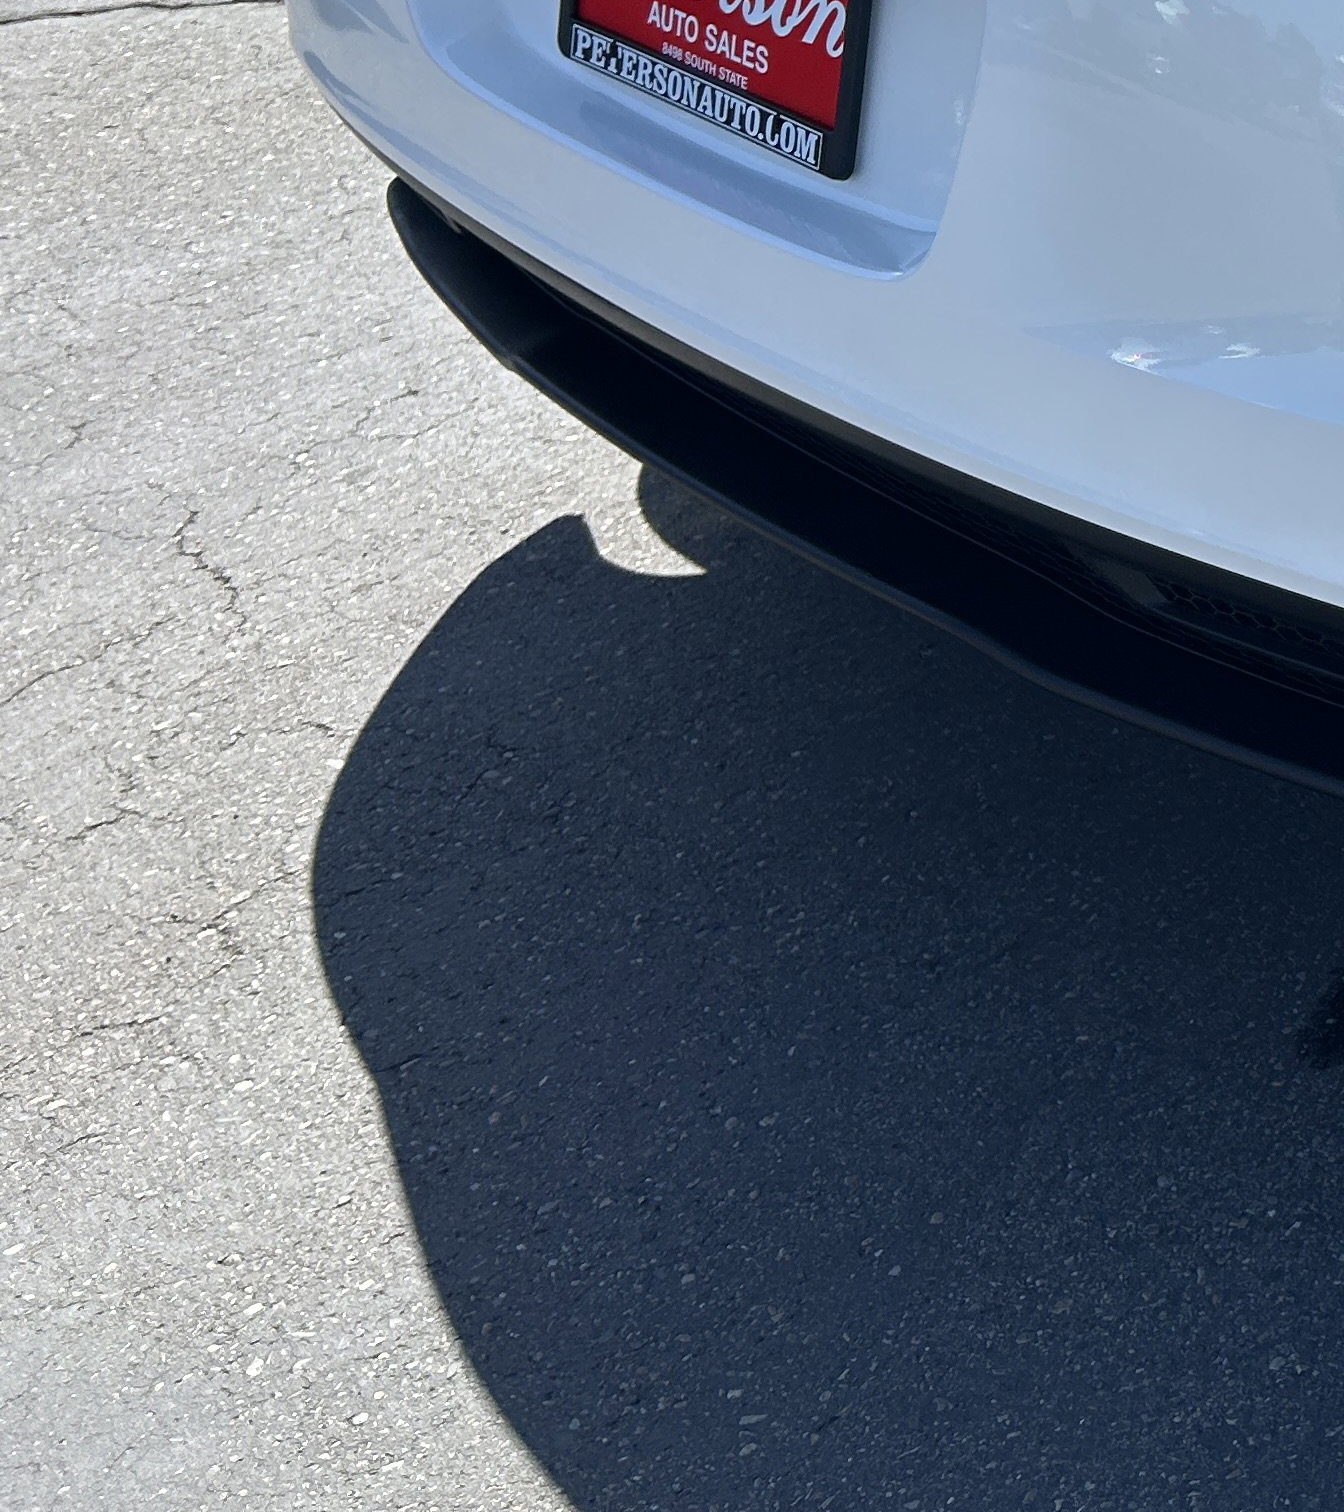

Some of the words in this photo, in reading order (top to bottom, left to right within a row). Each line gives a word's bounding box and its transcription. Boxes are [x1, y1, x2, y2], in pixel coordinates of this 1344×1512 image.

[646, 0, 699, 44] AUTO
[703, 23, 769, 74] SALES
[661, 41, 683, 62] 8498
[683, 50, 717, 78] SOUTH
[719, 66, 749, 90] STATE
